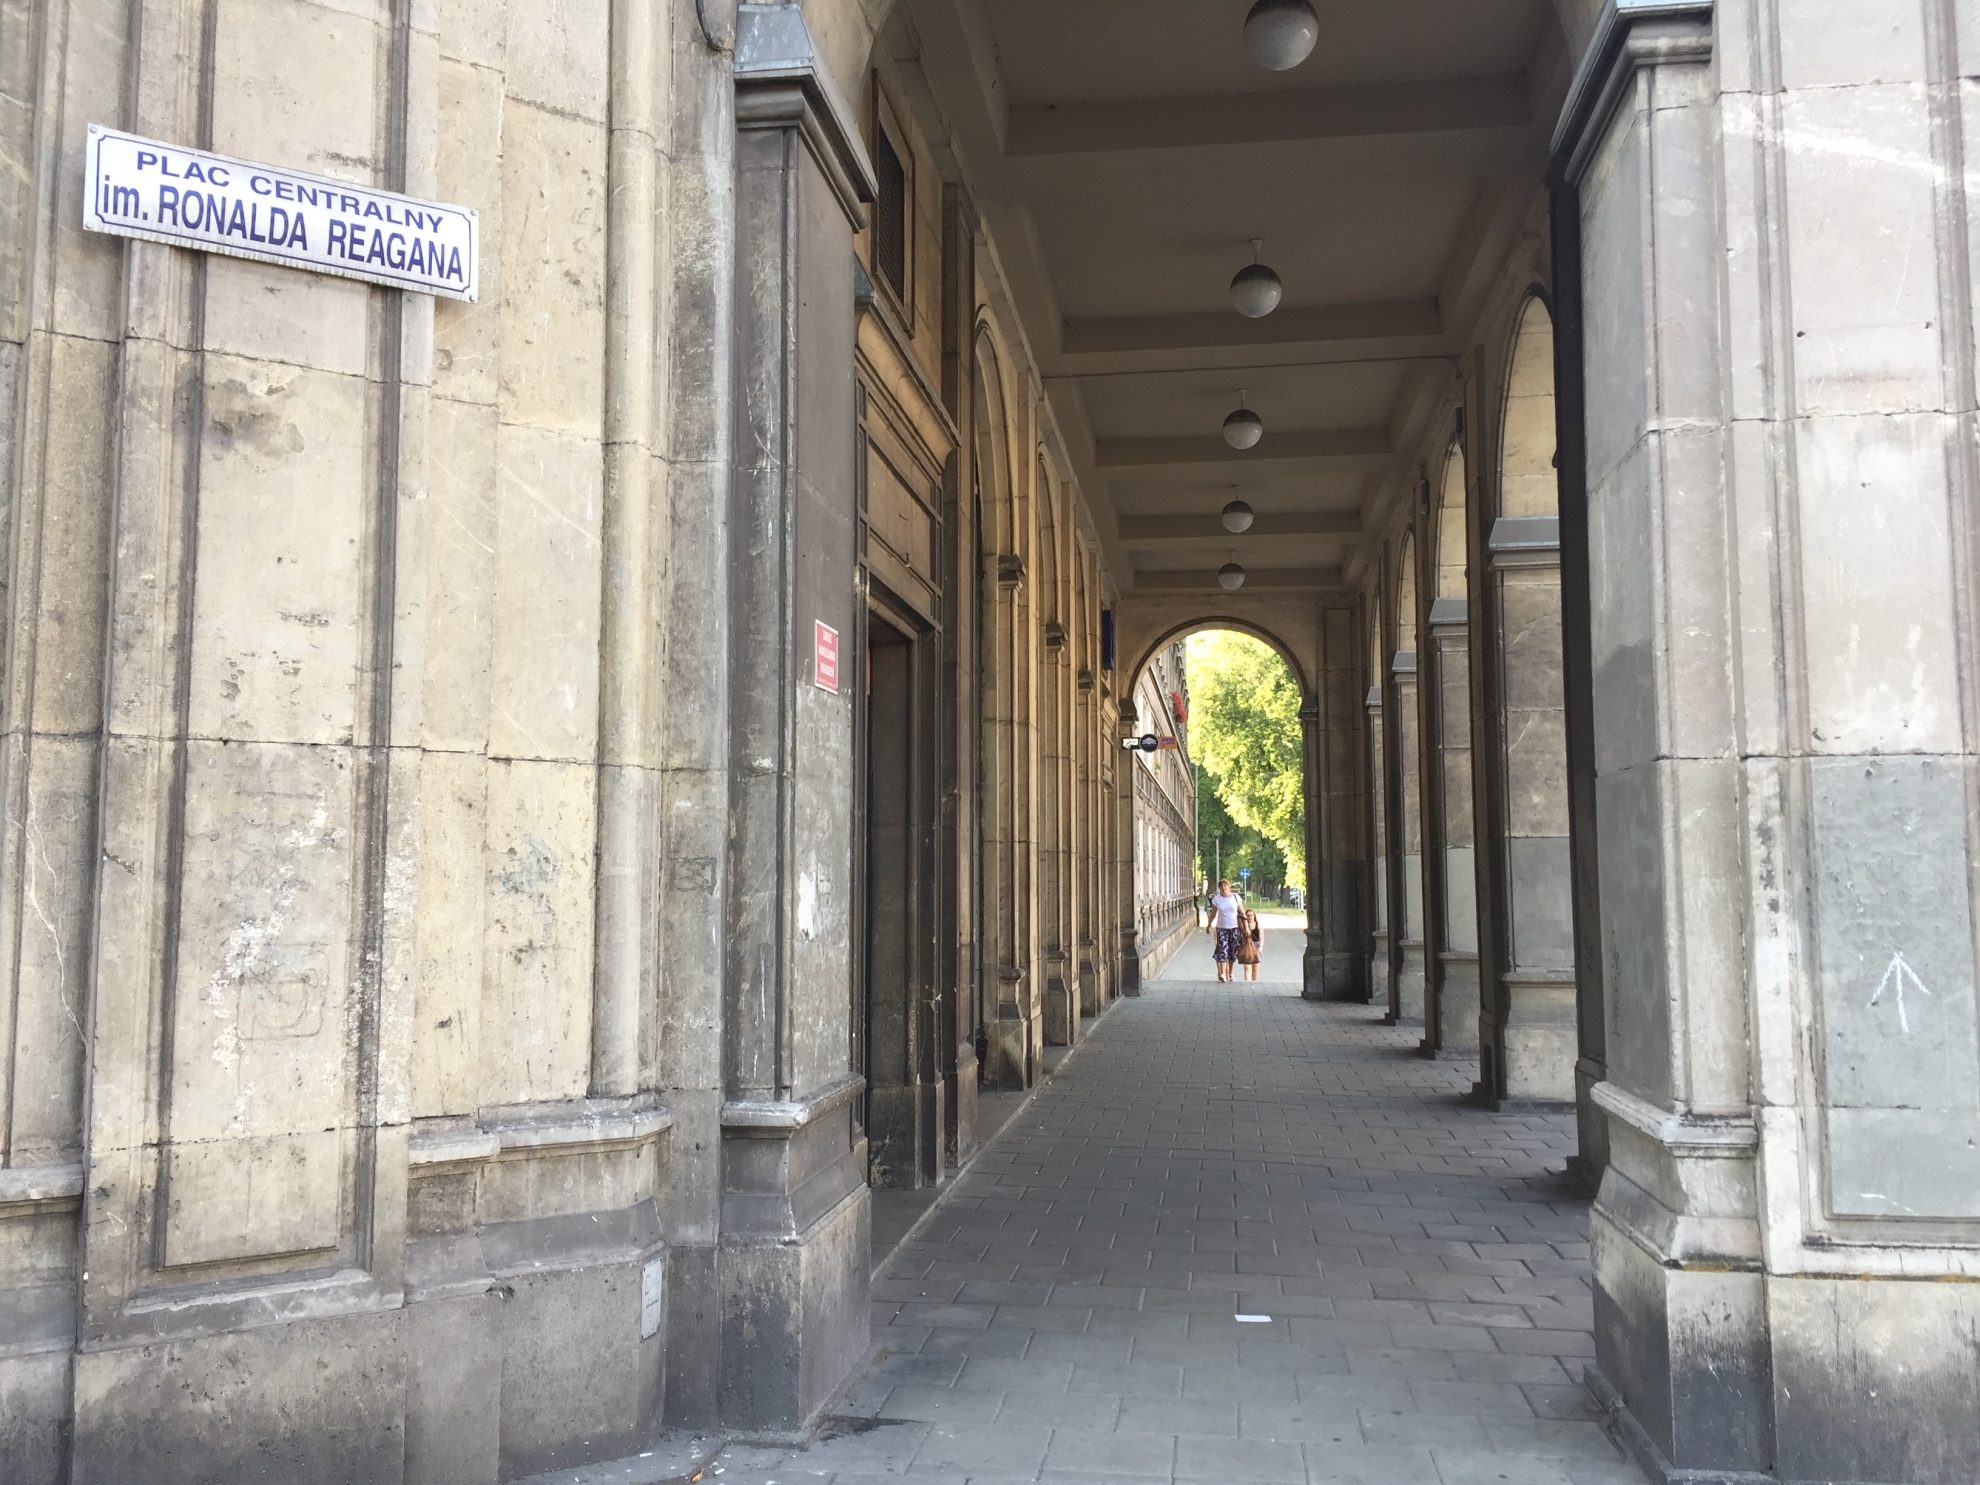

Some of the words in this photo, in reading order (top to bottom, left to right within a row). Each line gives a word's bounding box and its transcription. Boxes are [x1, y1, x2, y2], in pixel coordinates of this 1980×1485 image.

[103, 174, 148, 221] im.
[158, 184, 308, 251] RONALDA
[327, 218, 463, 283] REAGANA
[137, 151, 230, 187] PLAC
[250, 175, 443, 233] CENTRALNY
